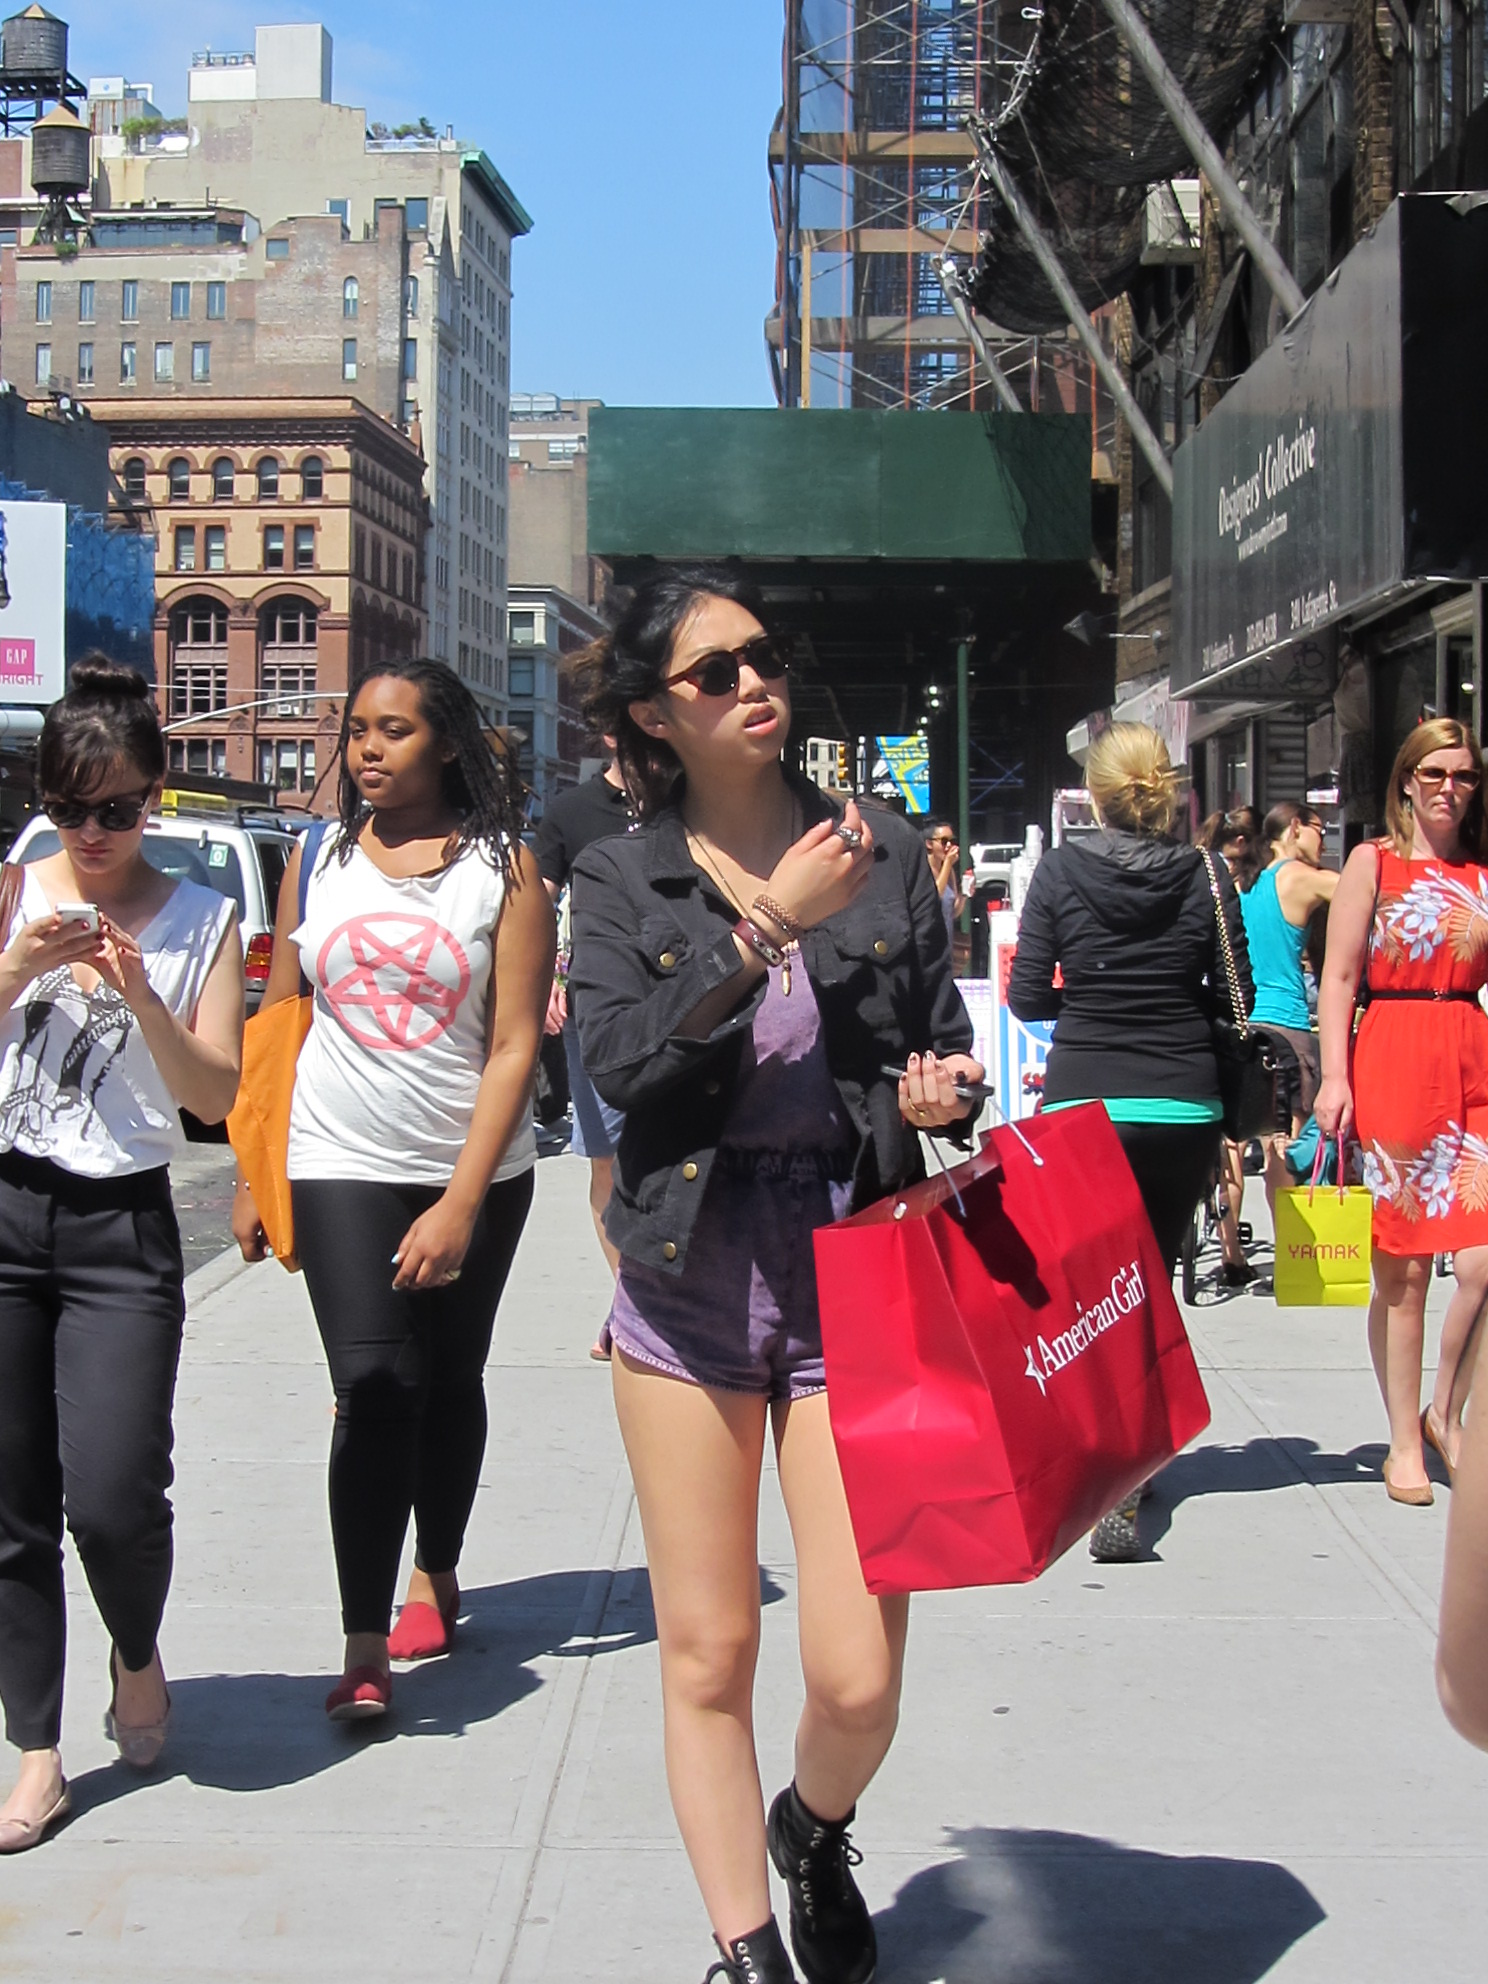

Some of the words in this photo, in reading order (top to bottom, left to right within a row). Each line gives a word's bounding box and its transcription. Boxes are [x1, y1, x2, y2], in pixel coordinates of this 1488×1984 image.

[1218, 452, 1263, 541] Designers'
[1265, 417, 1316, 500] Collective
[6, 648, 28, 664] GAP
[0, 674, 44, 685] RIGHT
[1288, 1244, 1360, 1259] YAMAK
